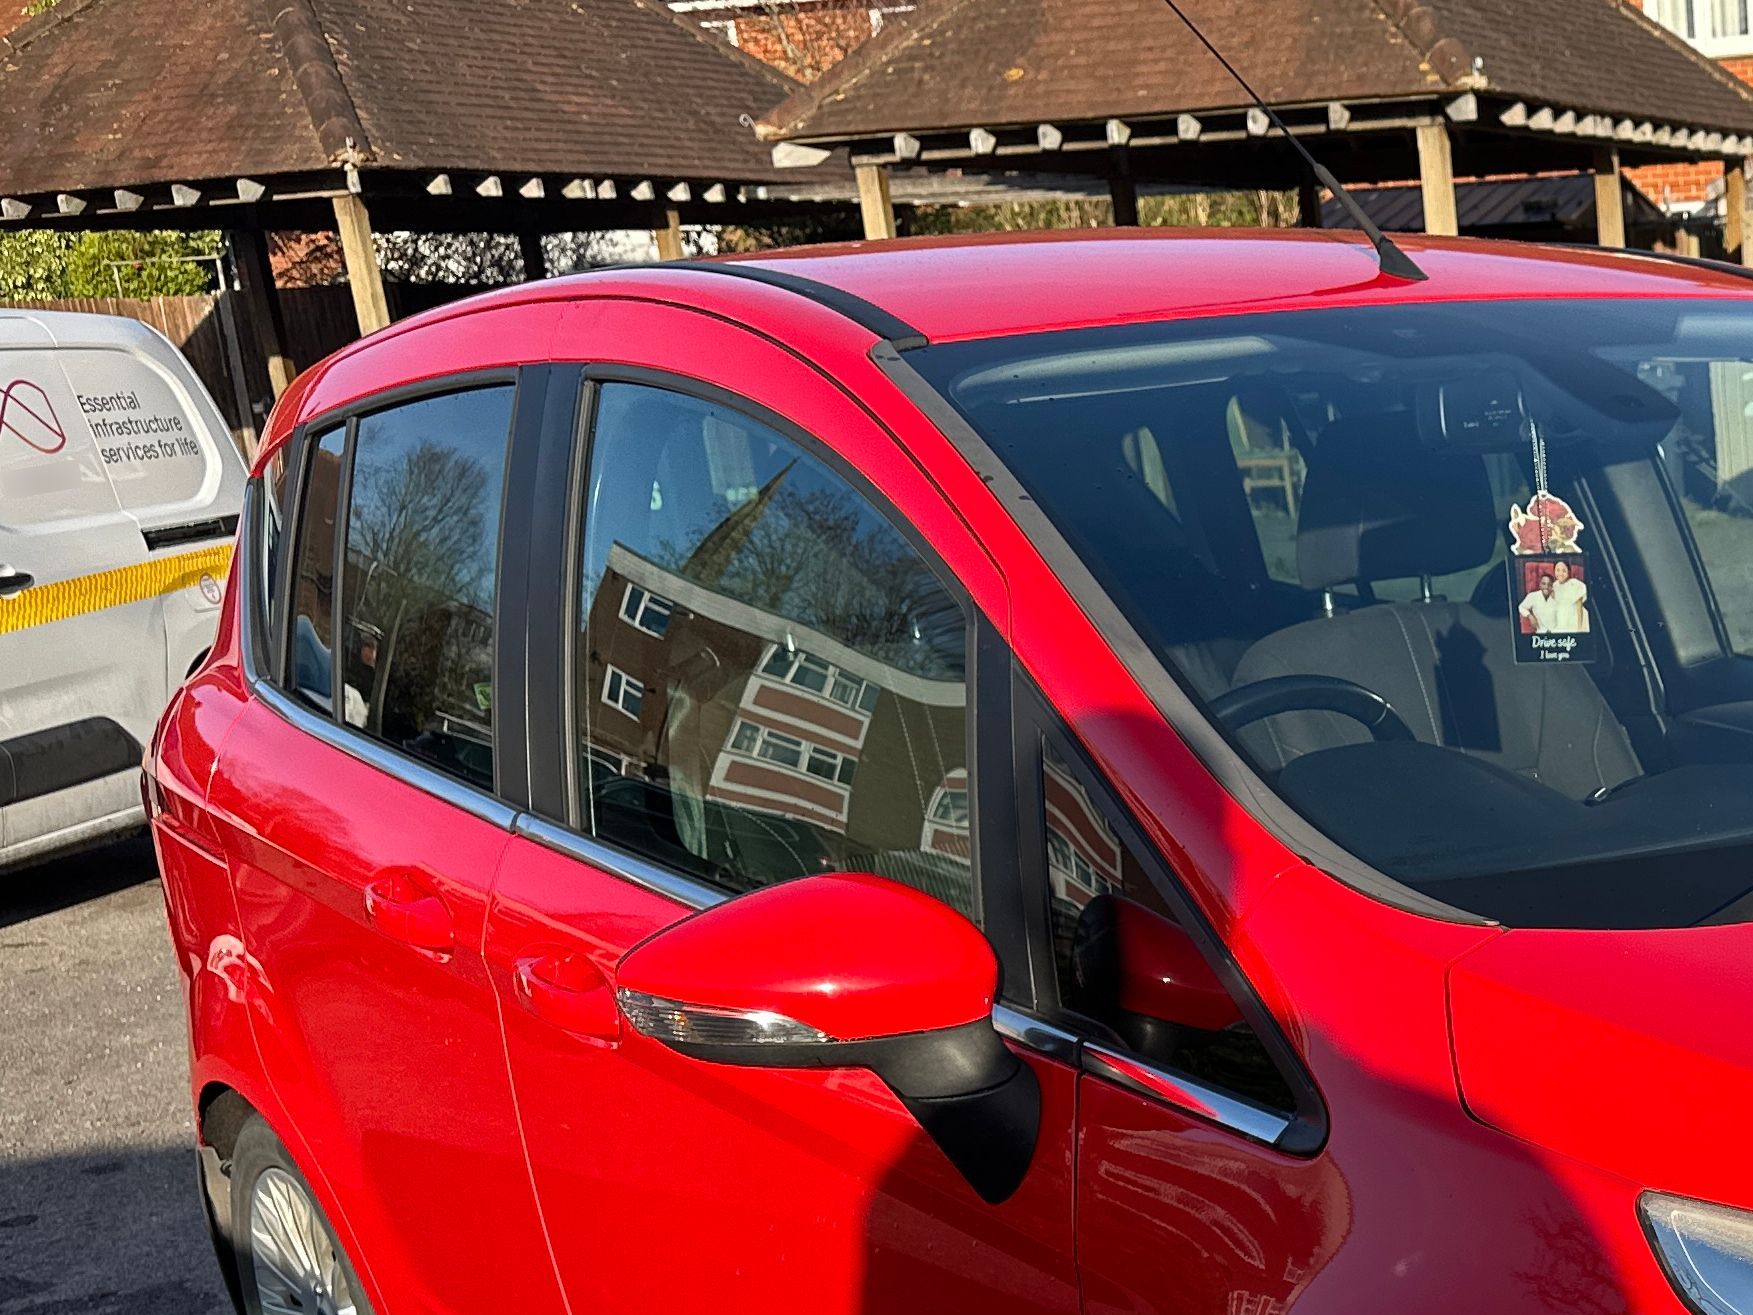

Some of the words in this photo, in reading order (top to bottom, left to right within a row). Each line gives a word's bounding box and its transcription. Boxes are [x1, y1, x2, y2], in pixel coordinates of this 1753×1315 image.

[77, 390, 141, 414] Essential
[87, 414, 183, 439] infrastructure
[100, 442, 160, 465] services
[158, 438, 178, 459] for
[175, 437, 200, 458] life
[1531, 635, 1558, 649] Drive
[1557, 635, 1577, 652] safe
